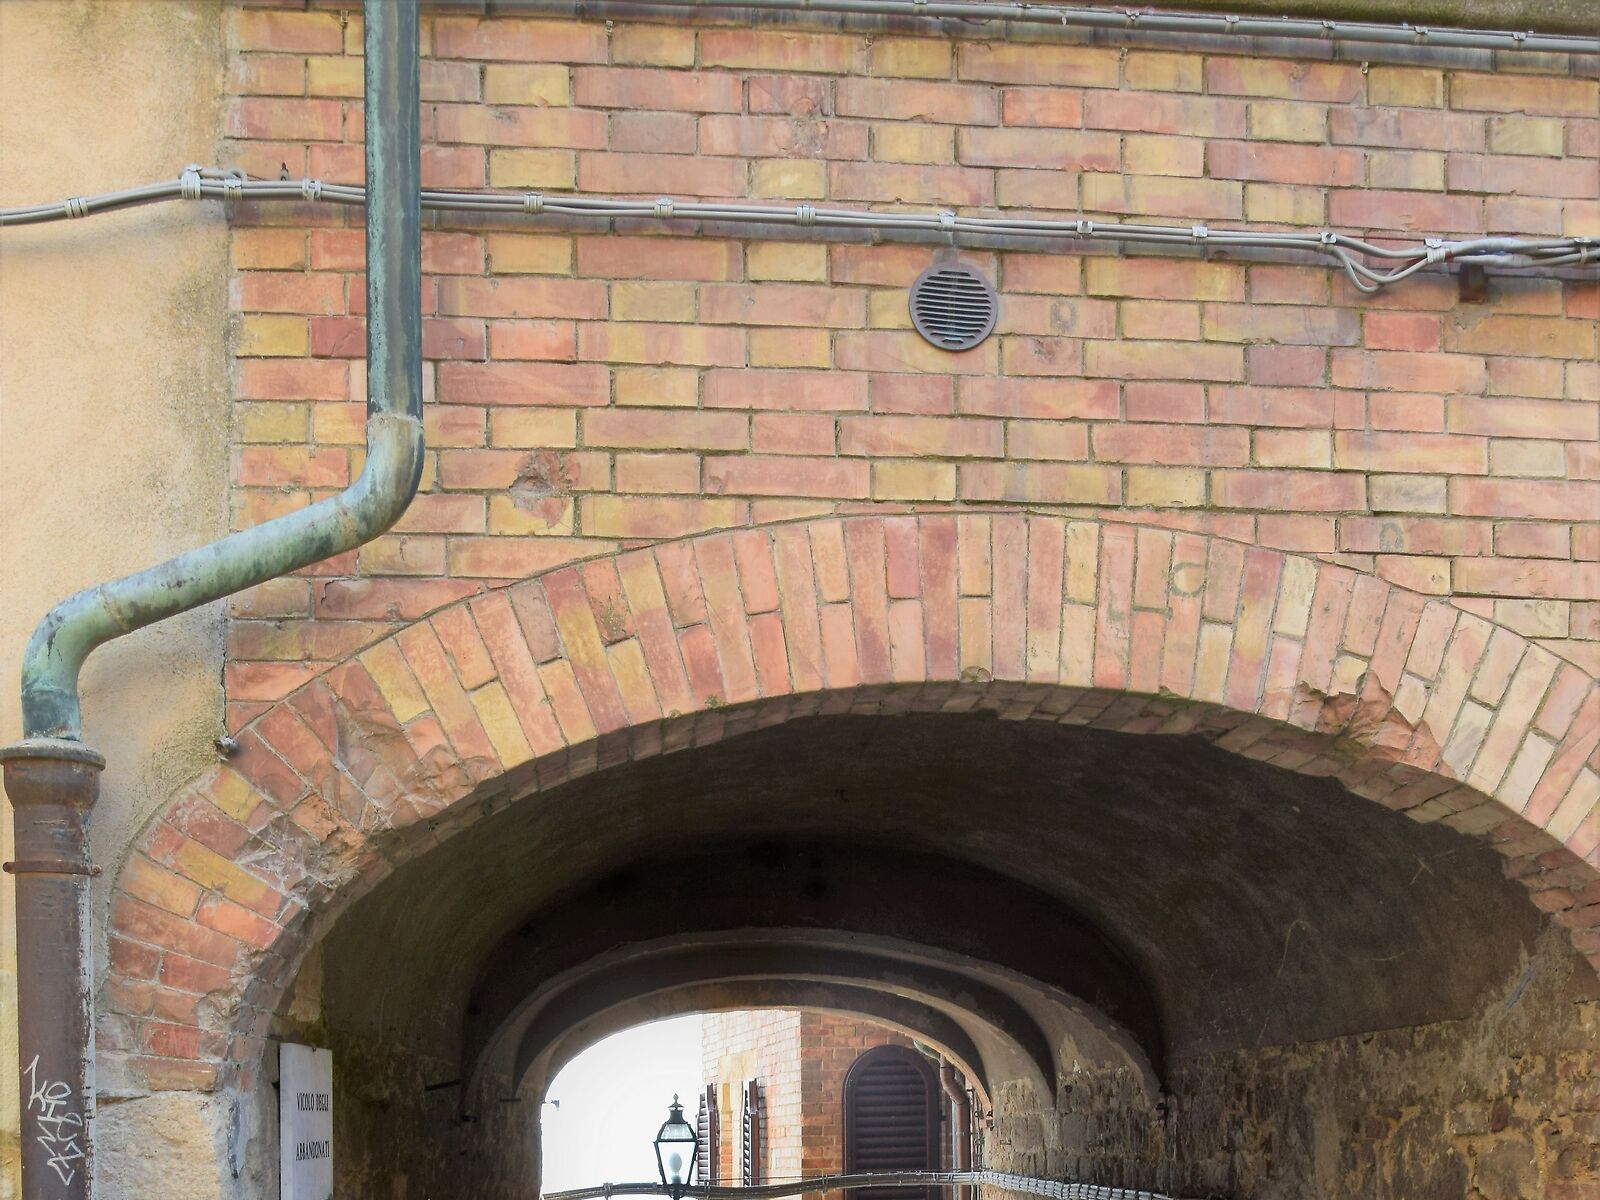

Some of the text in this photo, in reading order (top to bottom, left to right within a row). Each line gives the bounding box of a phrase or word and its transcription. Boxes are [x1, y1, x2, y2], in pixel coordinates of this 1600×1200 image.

[296, 1093, 329, 1111] VICOLO DEGLI
[296, 1141, 330, 1160] ABBANDONATI
